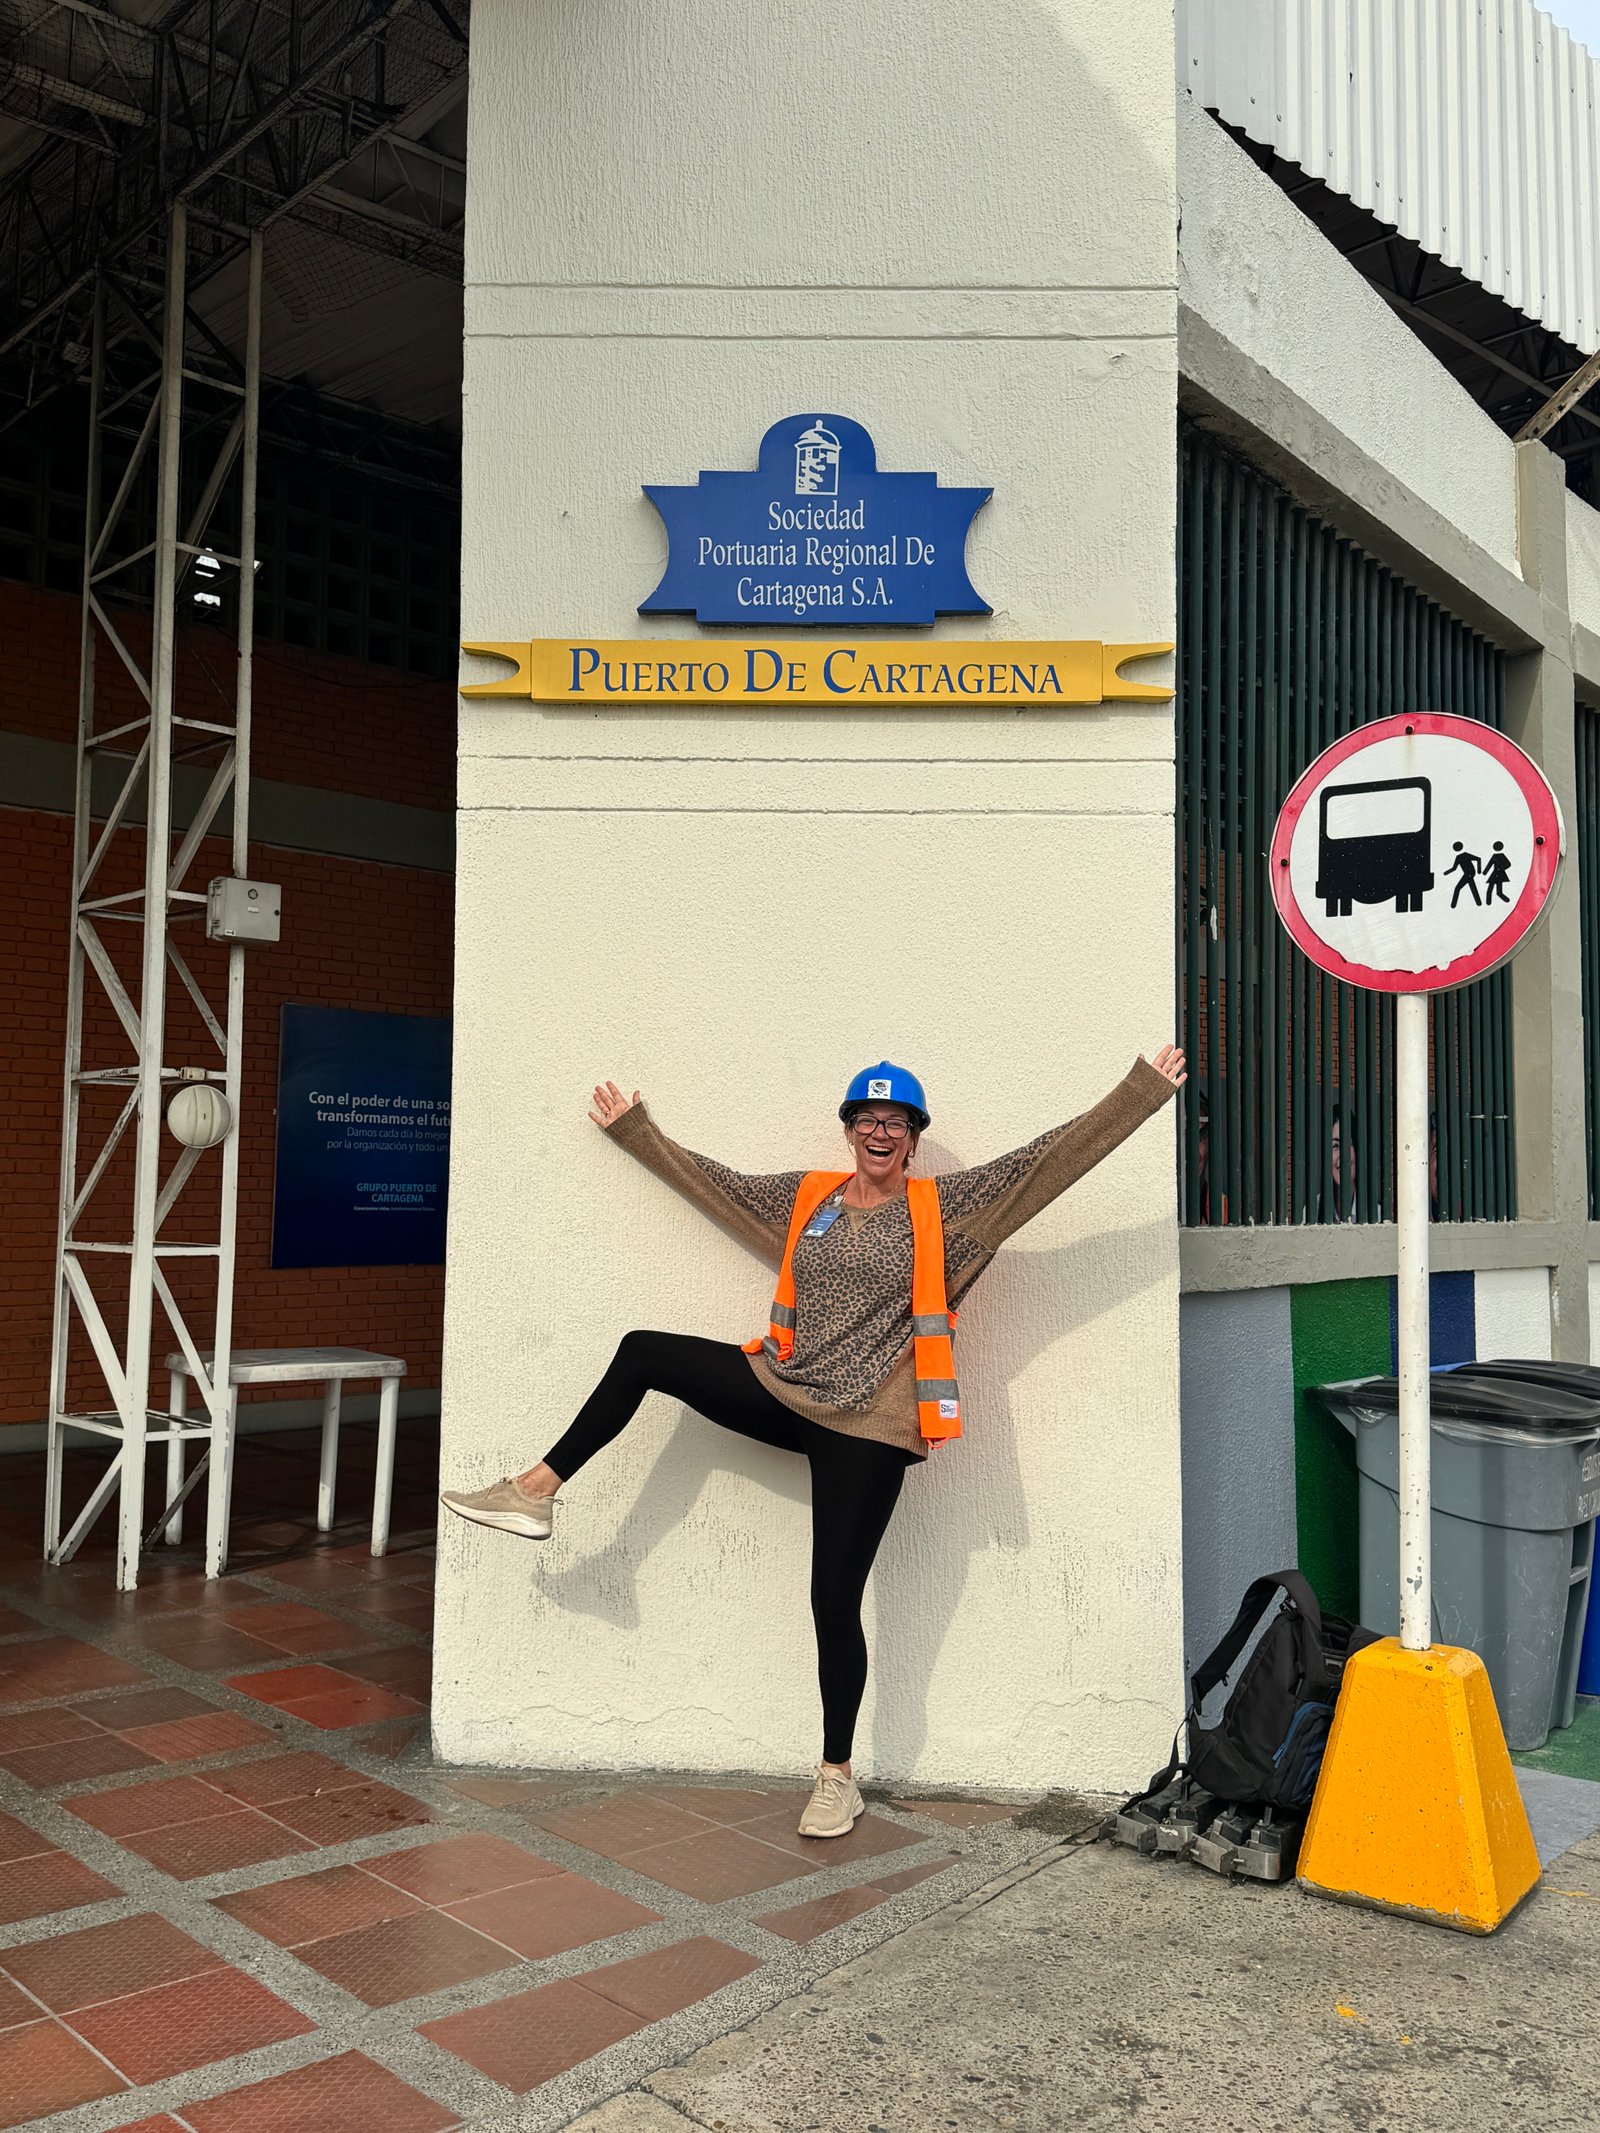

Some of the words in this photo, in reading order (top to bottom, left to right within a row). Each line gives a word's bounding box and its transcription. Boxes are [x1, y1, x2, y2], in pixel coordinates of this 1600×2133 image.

[768, 499, 865, 531] Sociedad
[698, 536, 797, 566] Portuaria
[805, 535, 897, 575] Regional
[905, 536, 935, 566] De
[737, 576, 844, 615] Cartagena
[851, 576, 894, 606] S.A.
[568, 647, 729, 693] PUERTO
[742, 648, 807, 694] DE
[823, 649, 1064, 695] CARTAGENA
[308, 1091, 335, 1105] Con
[337, 1092, 349, 1106] el
[352, 1094, 390, 1109] poder
[392, 1095, 409, 1109] de
[411, 1099, 434, 1110] una
[316, 1109, 414, 1125] transformamos
[416, 1113, 428, 1126] el
[346, 1126, 377, 1138] Damos
[378, 1127, 399, 1138] cada
[414, 1129, 423, 1140] lo
[424, 1130, 449, 1142] mejor
[326, 1140, 343, 1151] por
[344, 1139, 352, 1150] la
[353, 1140, 408, 1152] organización
[408, 1143, 414, 1153] y
[415, 1142, 434, 1152] todo
[356, 1182, 388, 1192] GRUPO
[390, 1183, 424, 1193] PUERTO
[425, 1183, 438, 1193] DE
[371, 1193, 424, 1203] CARTAGENA
